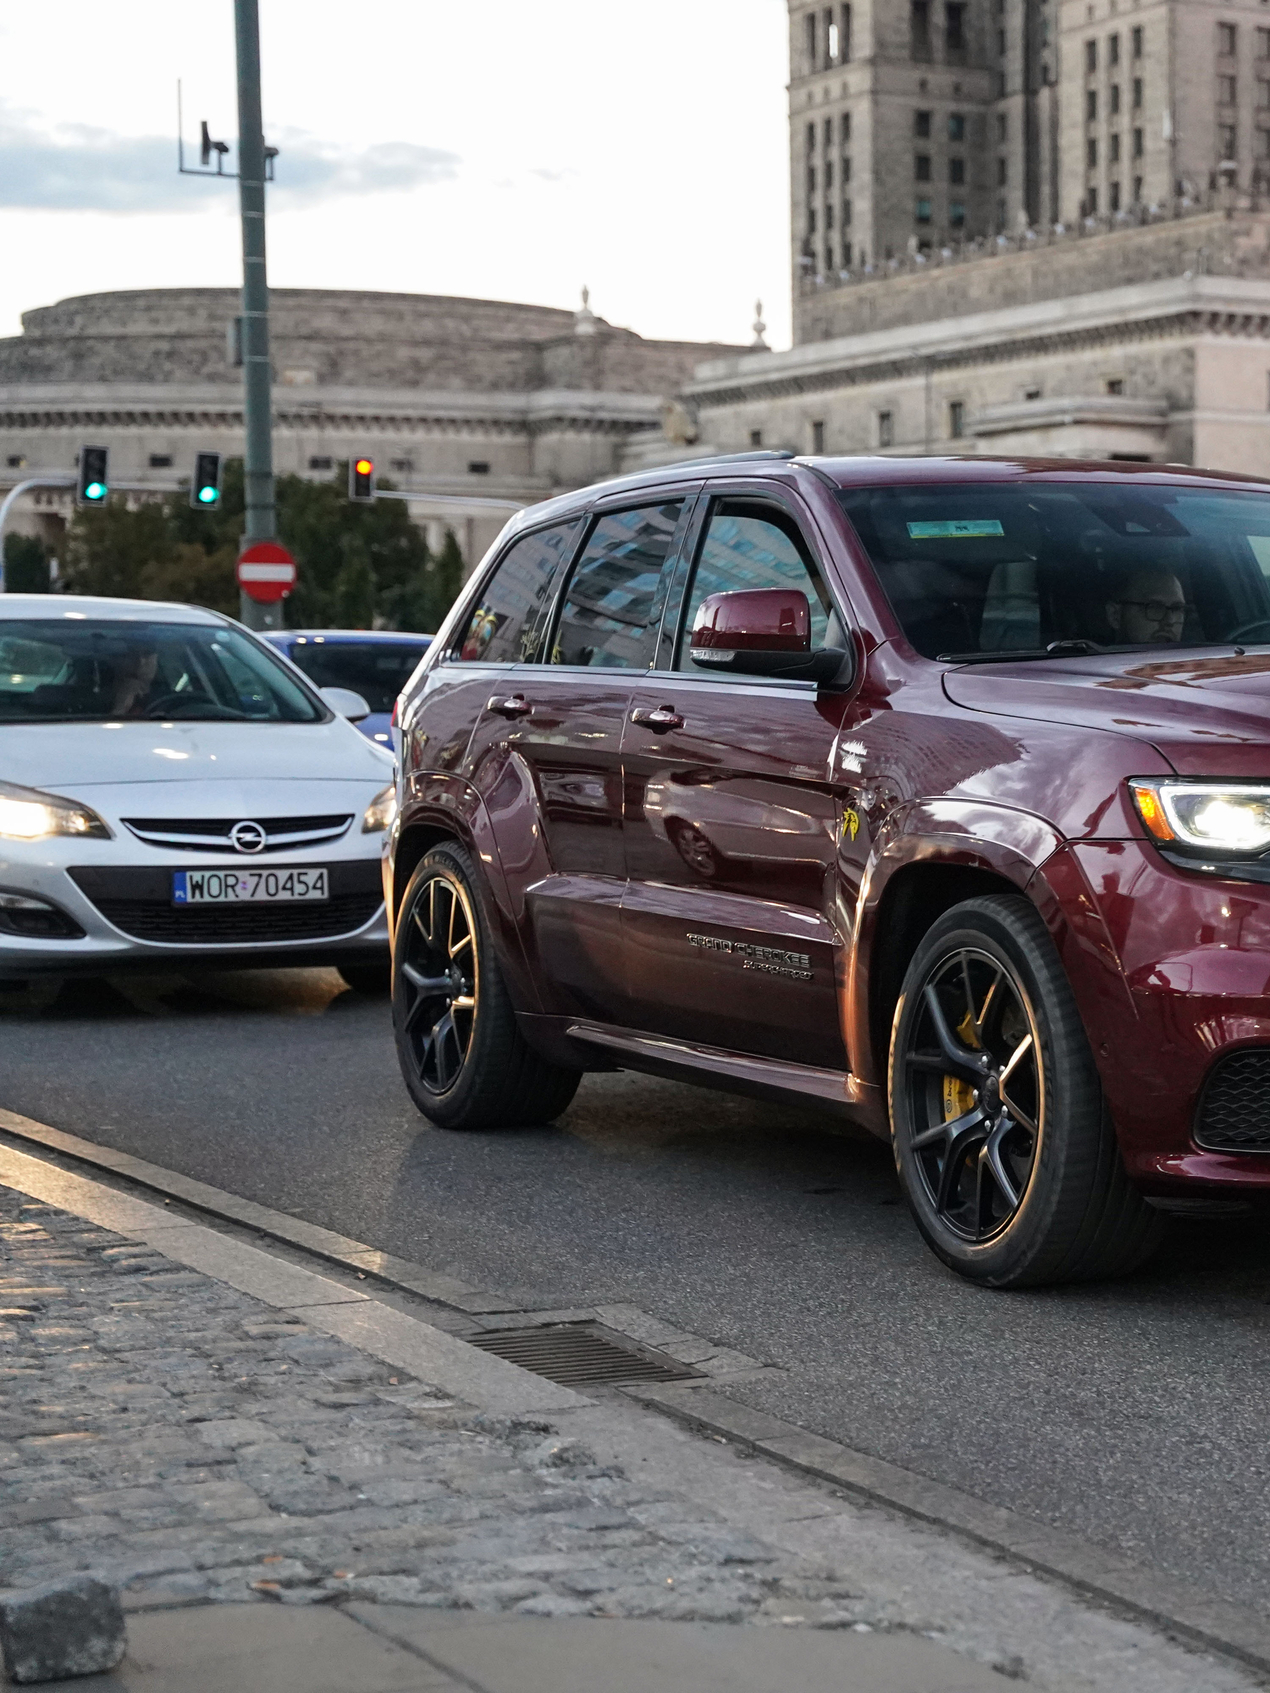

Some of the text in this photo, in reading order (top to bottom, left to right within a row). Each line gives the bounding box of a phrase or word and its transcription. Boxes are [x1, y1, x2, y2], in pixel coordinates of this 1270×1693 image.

[188, 871, 325, 899] WOR 70454
[686, 932, 811, 969] GRAND CHEROKEE
